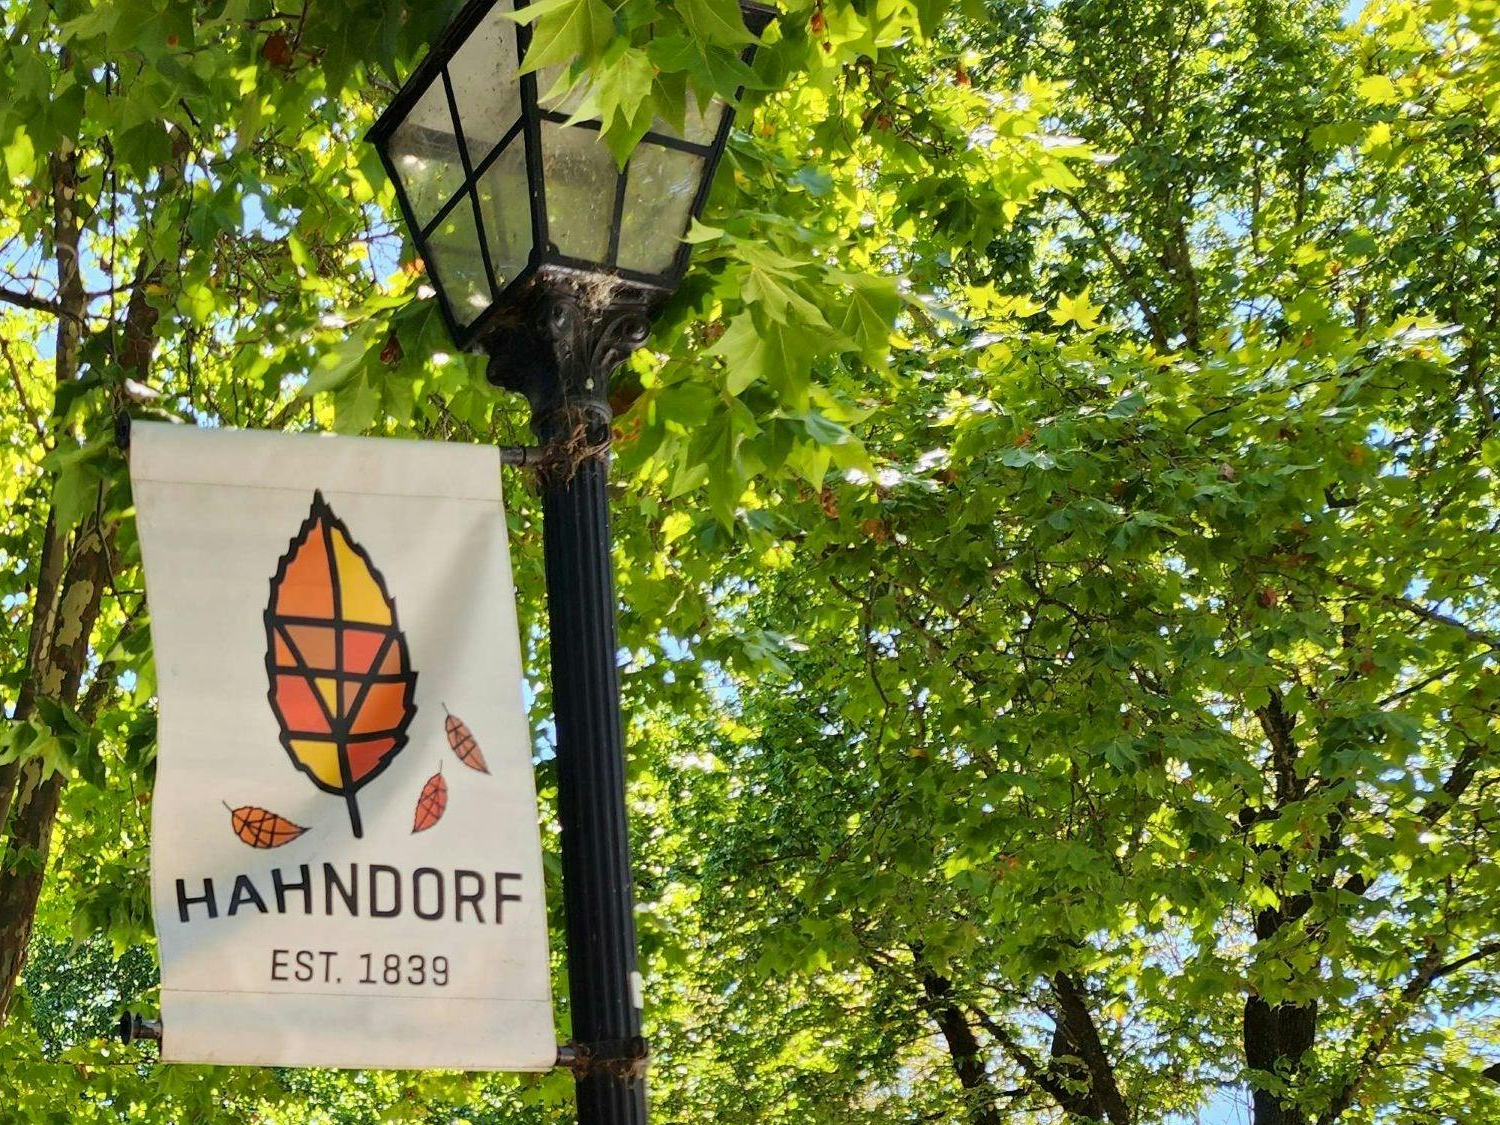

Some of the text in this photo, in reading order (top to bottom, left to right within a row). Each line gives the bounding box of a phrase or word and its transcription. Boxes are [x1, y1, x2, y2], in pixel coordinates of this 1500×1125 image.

[176, 863, 523, 924] HAHNDORF
[271, 949, 449, 986] EST. 1839
